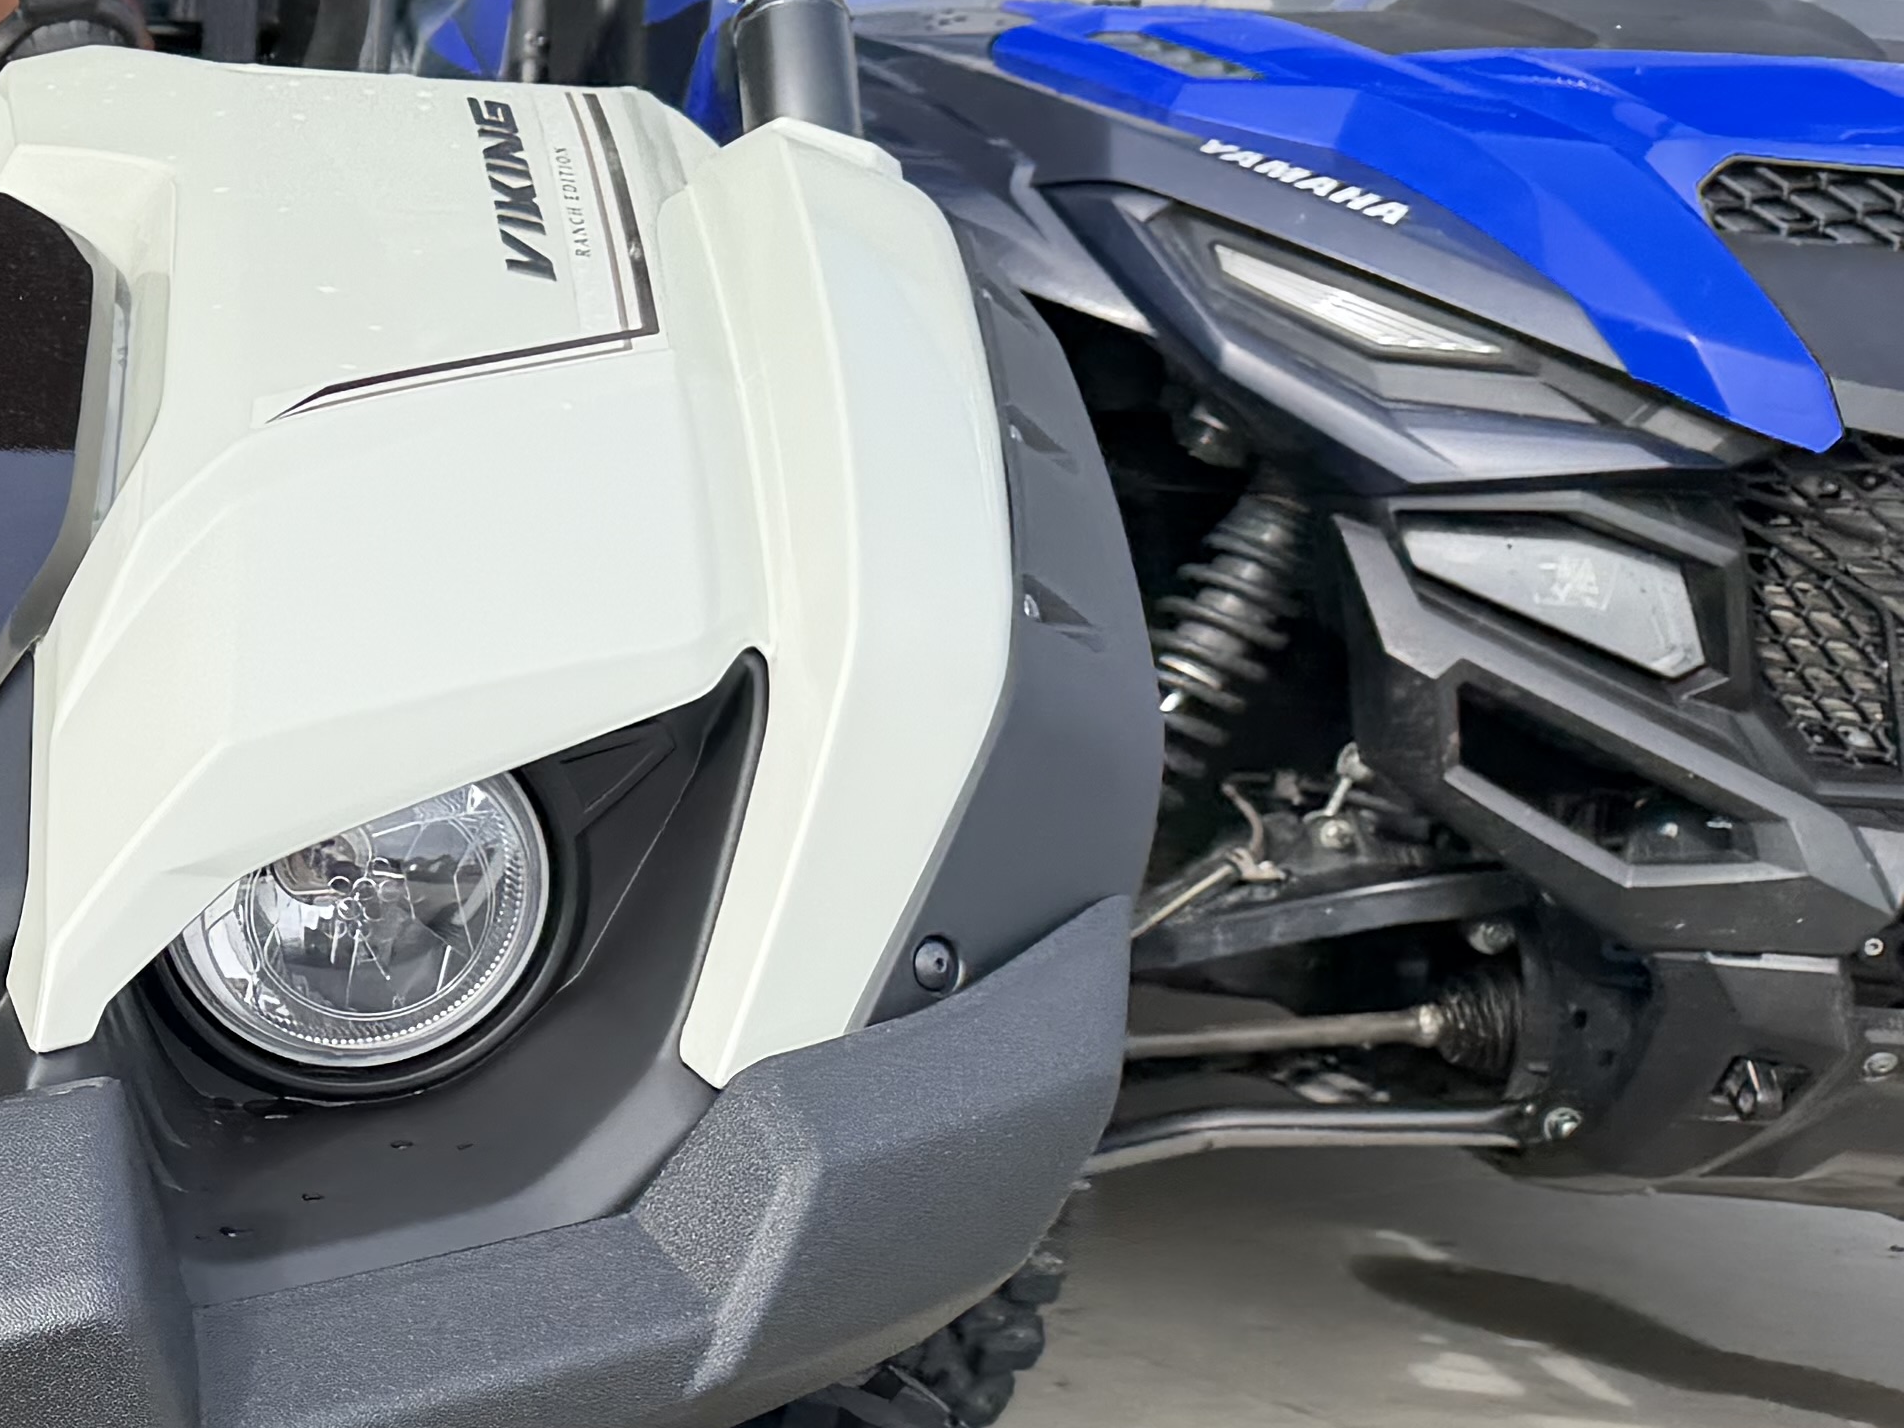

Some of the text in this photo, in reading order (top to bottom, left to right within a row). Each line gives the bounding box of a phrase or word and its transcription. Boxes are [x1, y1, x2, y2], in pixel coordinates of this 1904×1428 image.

[467, 97, 557, 282] VIKING
[553, 146, 592, 258] RANCH EDITION
[1199, 138, 1410, 225] YAMAHA
